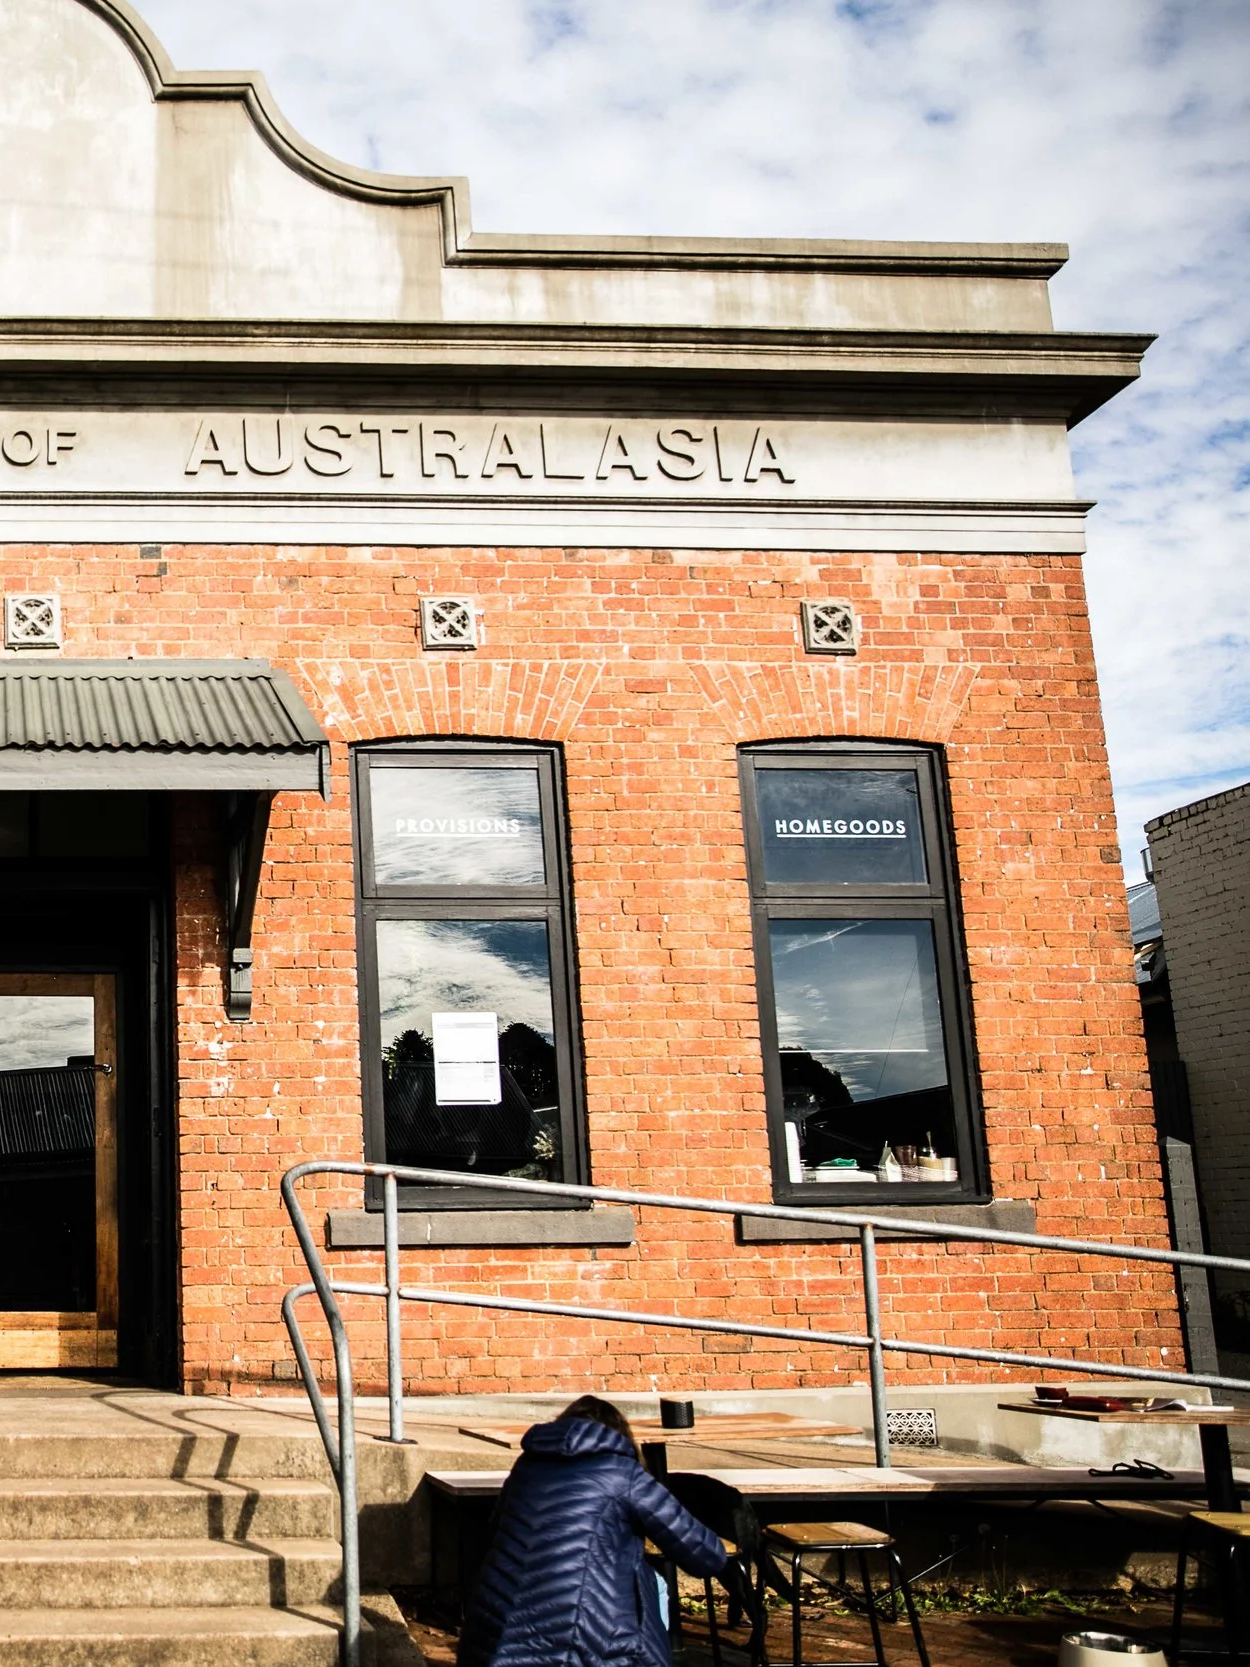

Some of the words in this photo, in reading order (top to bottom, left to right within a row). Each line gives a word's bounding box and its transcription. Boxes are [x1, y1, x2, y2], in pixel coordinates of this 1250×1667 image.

[1, 427, 78, 467] OF
[184, 417, 797, 485] AUSTRALASIA
[395, 818, 520, 834] PROVISIONS
[775, 819, 907, 835] HOMEGOODS
